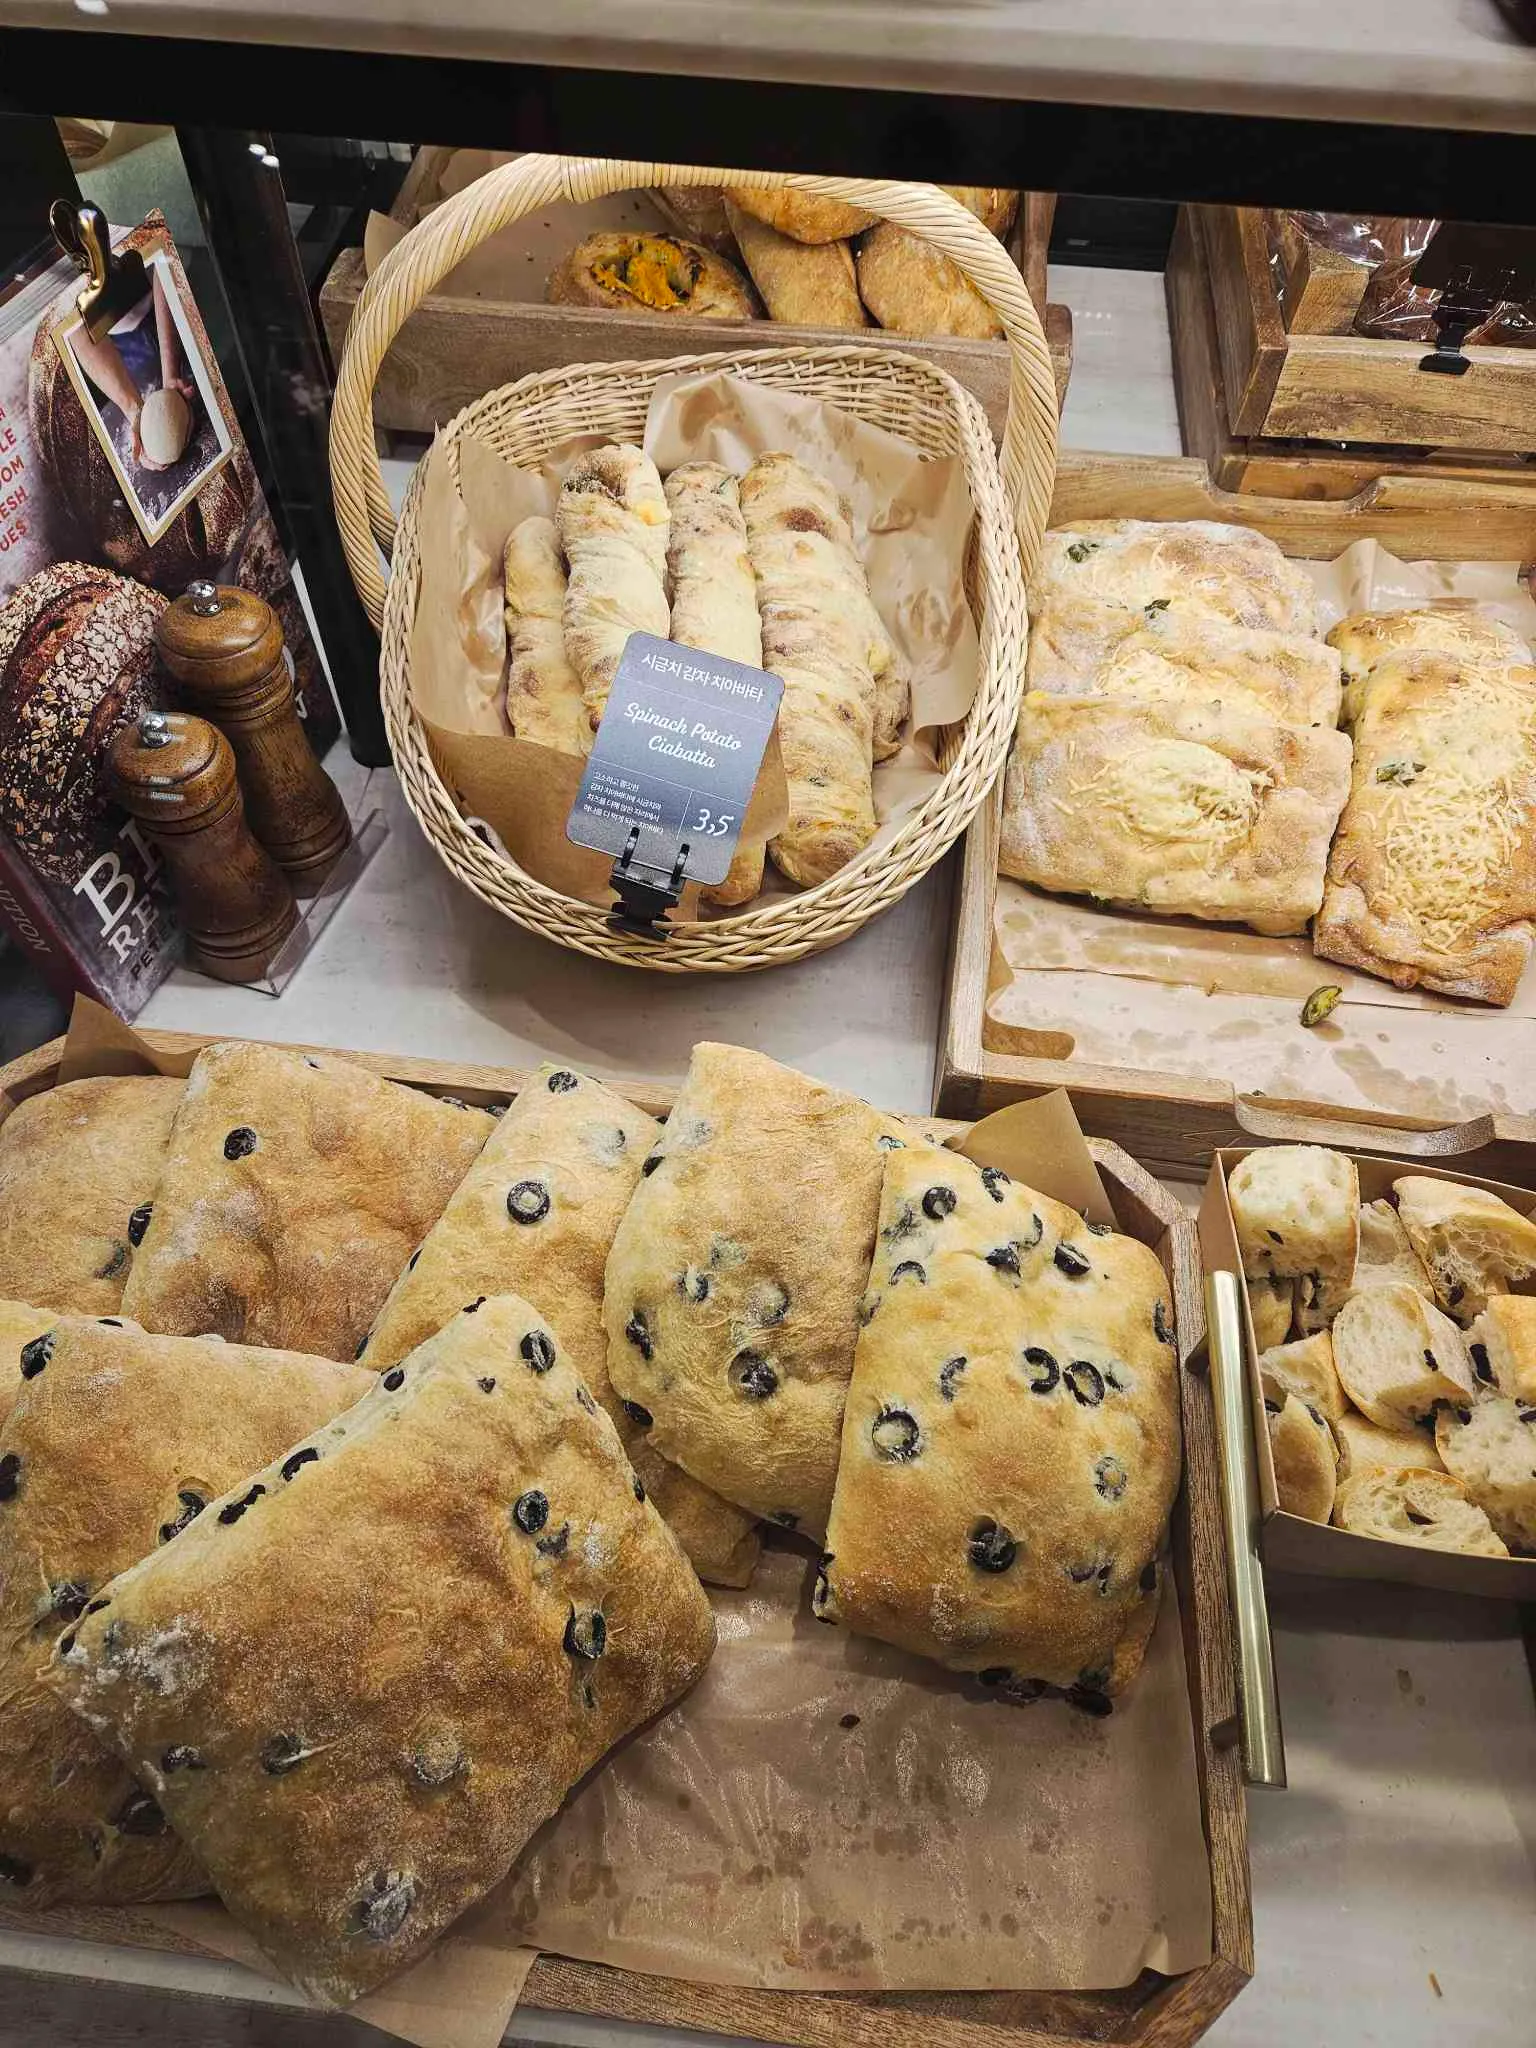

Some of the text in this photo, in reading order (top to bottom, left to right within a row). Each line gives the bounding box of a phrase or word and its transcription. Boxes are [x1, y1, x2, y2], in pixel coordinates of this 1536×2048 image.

[0, 455, 25, 490] OM
[0, 486, 28, 523] ESH
[641, 653, 764, 702] 시금치 감자 치아바타
[624, 702, 742, 751] Spinach Potato
[648, 735, 716, 768] Ciabatta
